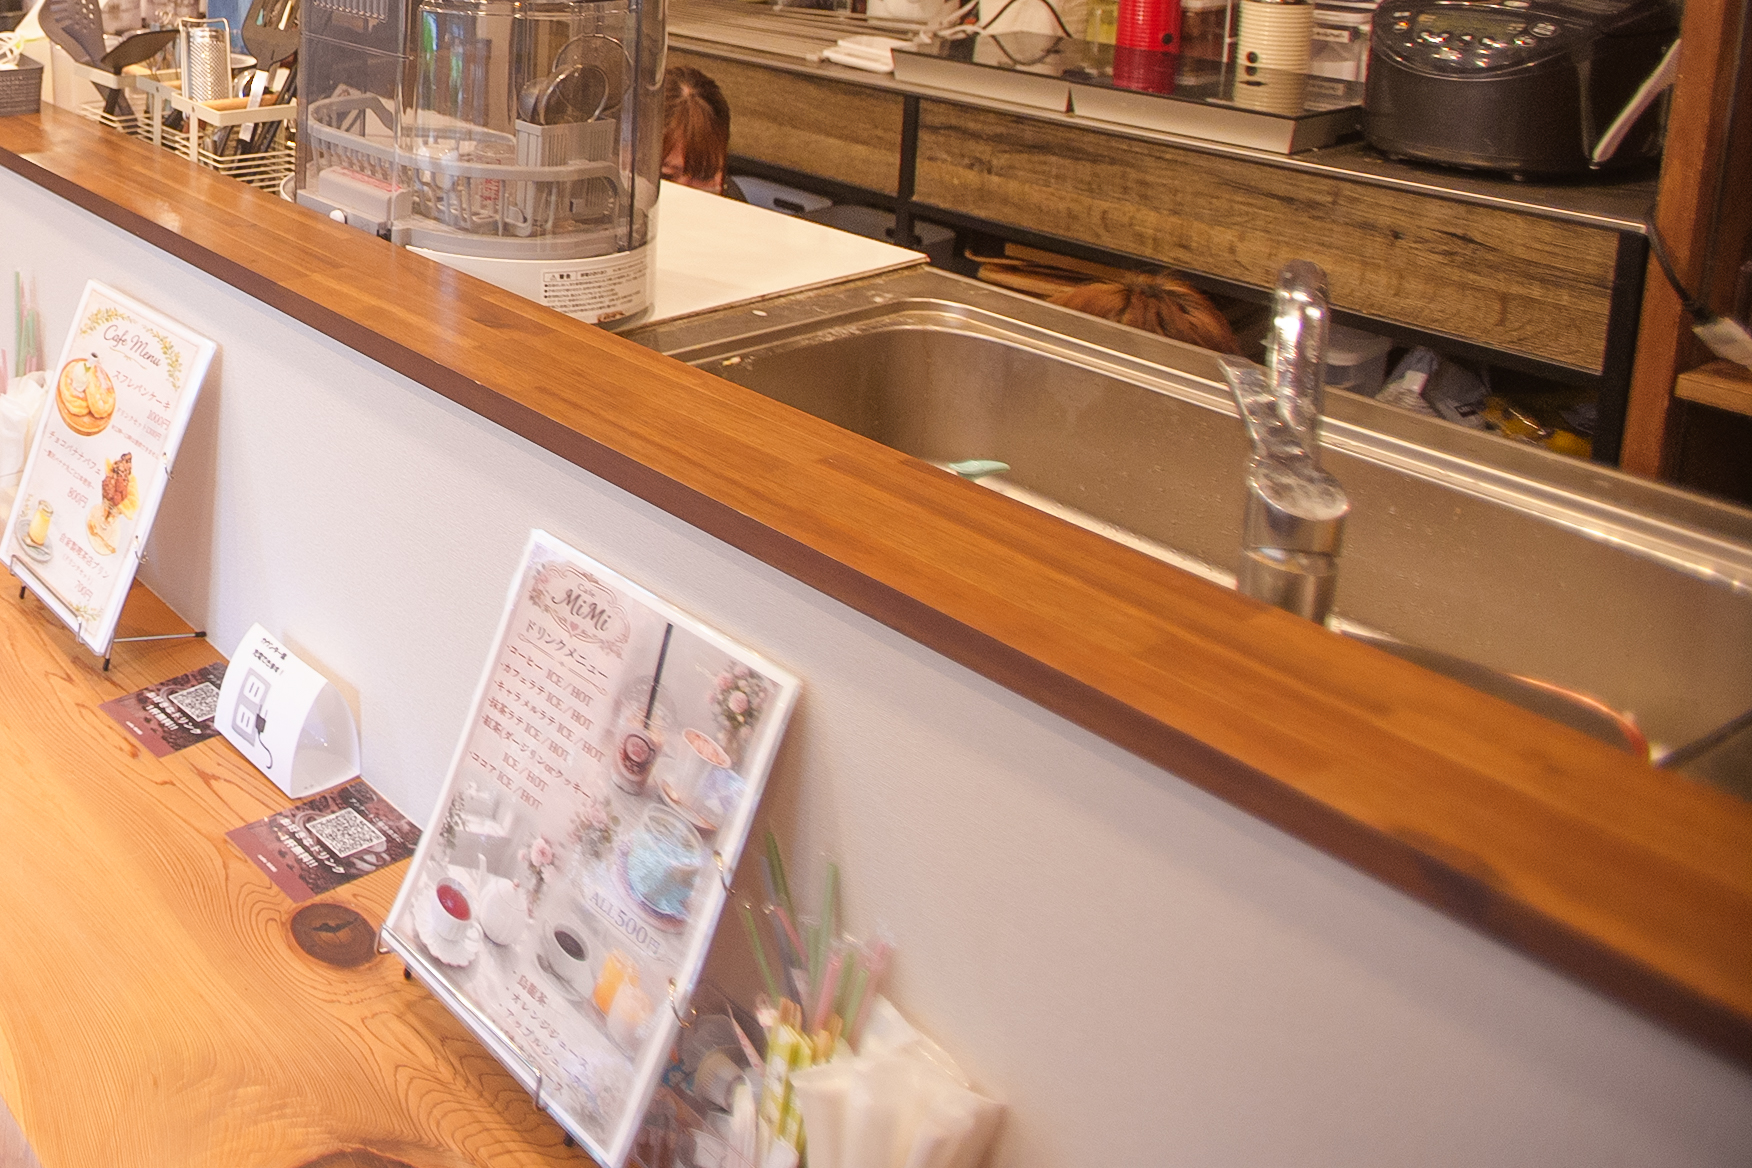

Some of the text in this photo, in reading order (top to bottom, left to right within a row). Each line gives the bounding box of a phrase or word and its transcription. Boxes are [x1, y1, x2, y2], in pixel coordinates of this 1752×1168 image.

[103, 324, 162, 368] Cafe Menu
[112, 369, 172, 411] スフレパンケーキ
[48, 430, 102, 476] チョコバナナパフェ
[551, 588, 612, 632] MiMi
[525, 619, 609, 680] ドリンクメニュー
[279, 816, 347, 876] お好きなドリンク
